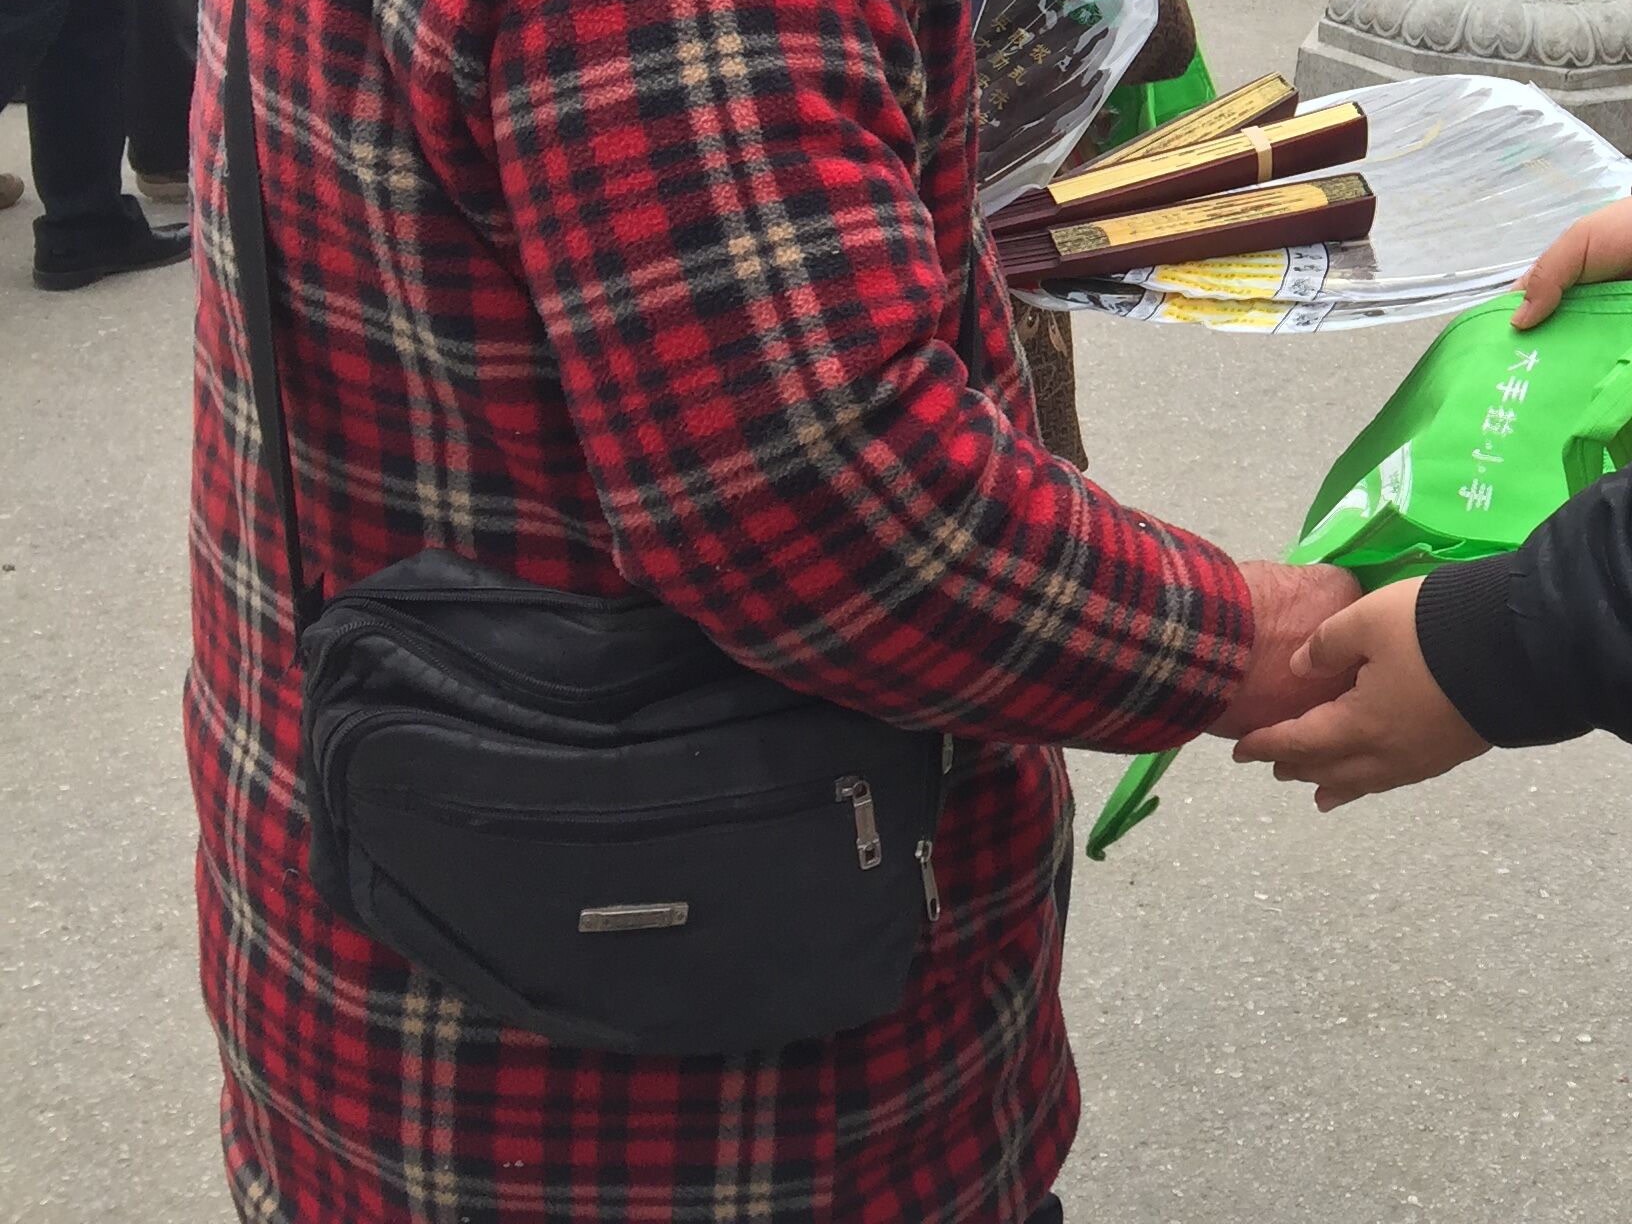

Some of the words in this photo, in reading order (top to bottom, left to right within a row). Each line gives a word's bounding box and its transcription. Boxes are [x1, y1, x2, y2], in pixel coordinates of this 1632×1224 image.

[1458, 348, 1540, 512] 大手拉小手
